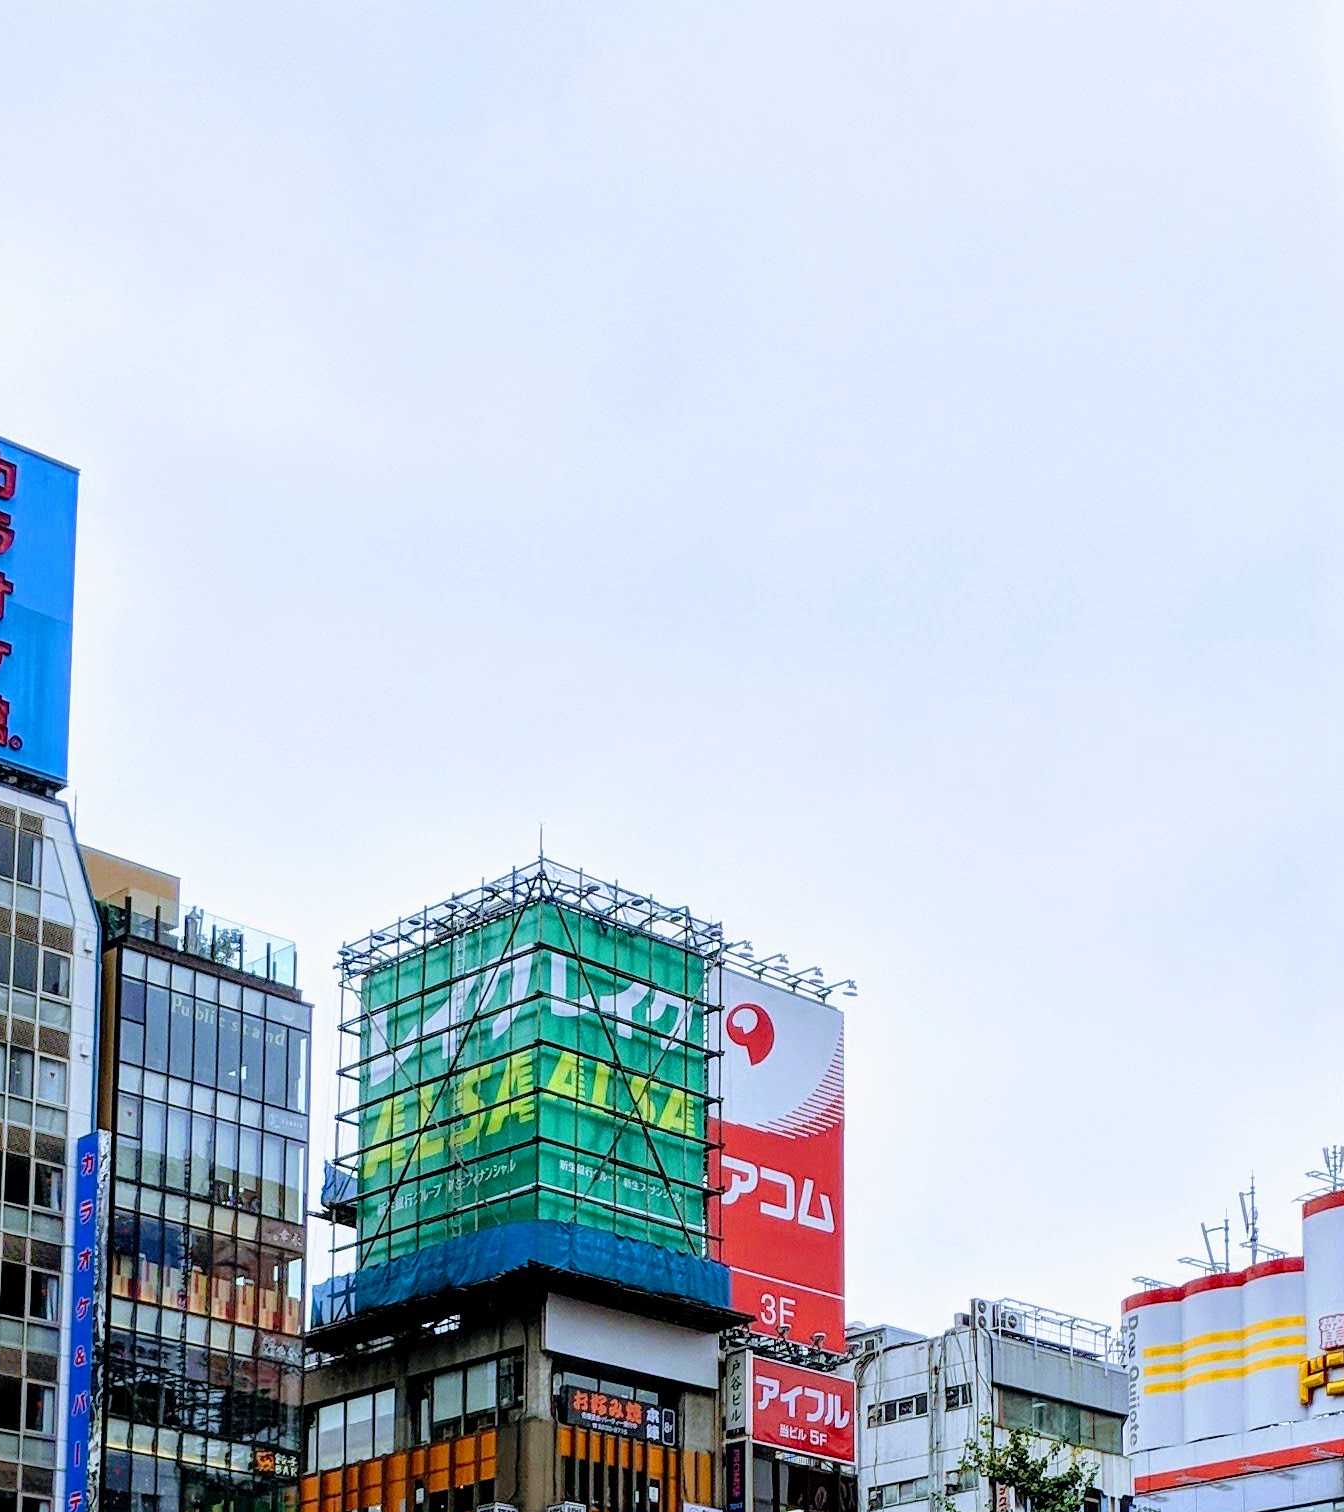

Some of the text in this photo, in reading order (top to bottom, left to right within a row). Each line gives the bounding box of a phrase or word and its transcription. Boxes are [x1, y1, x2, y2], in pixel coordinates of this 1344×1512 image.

[369, 943, 535, 1087] レイク
[551, 951, 694, 1051] レイク
[364, 1048, 537, 1179] ALSA
[542, 1051, 697, 1137] ALSA
[721, 1155, 835, 1234] アコム
[755, 1375, 851, 1429] アイフル
[780, 1424, 828, 1447] 当ビル 5F
